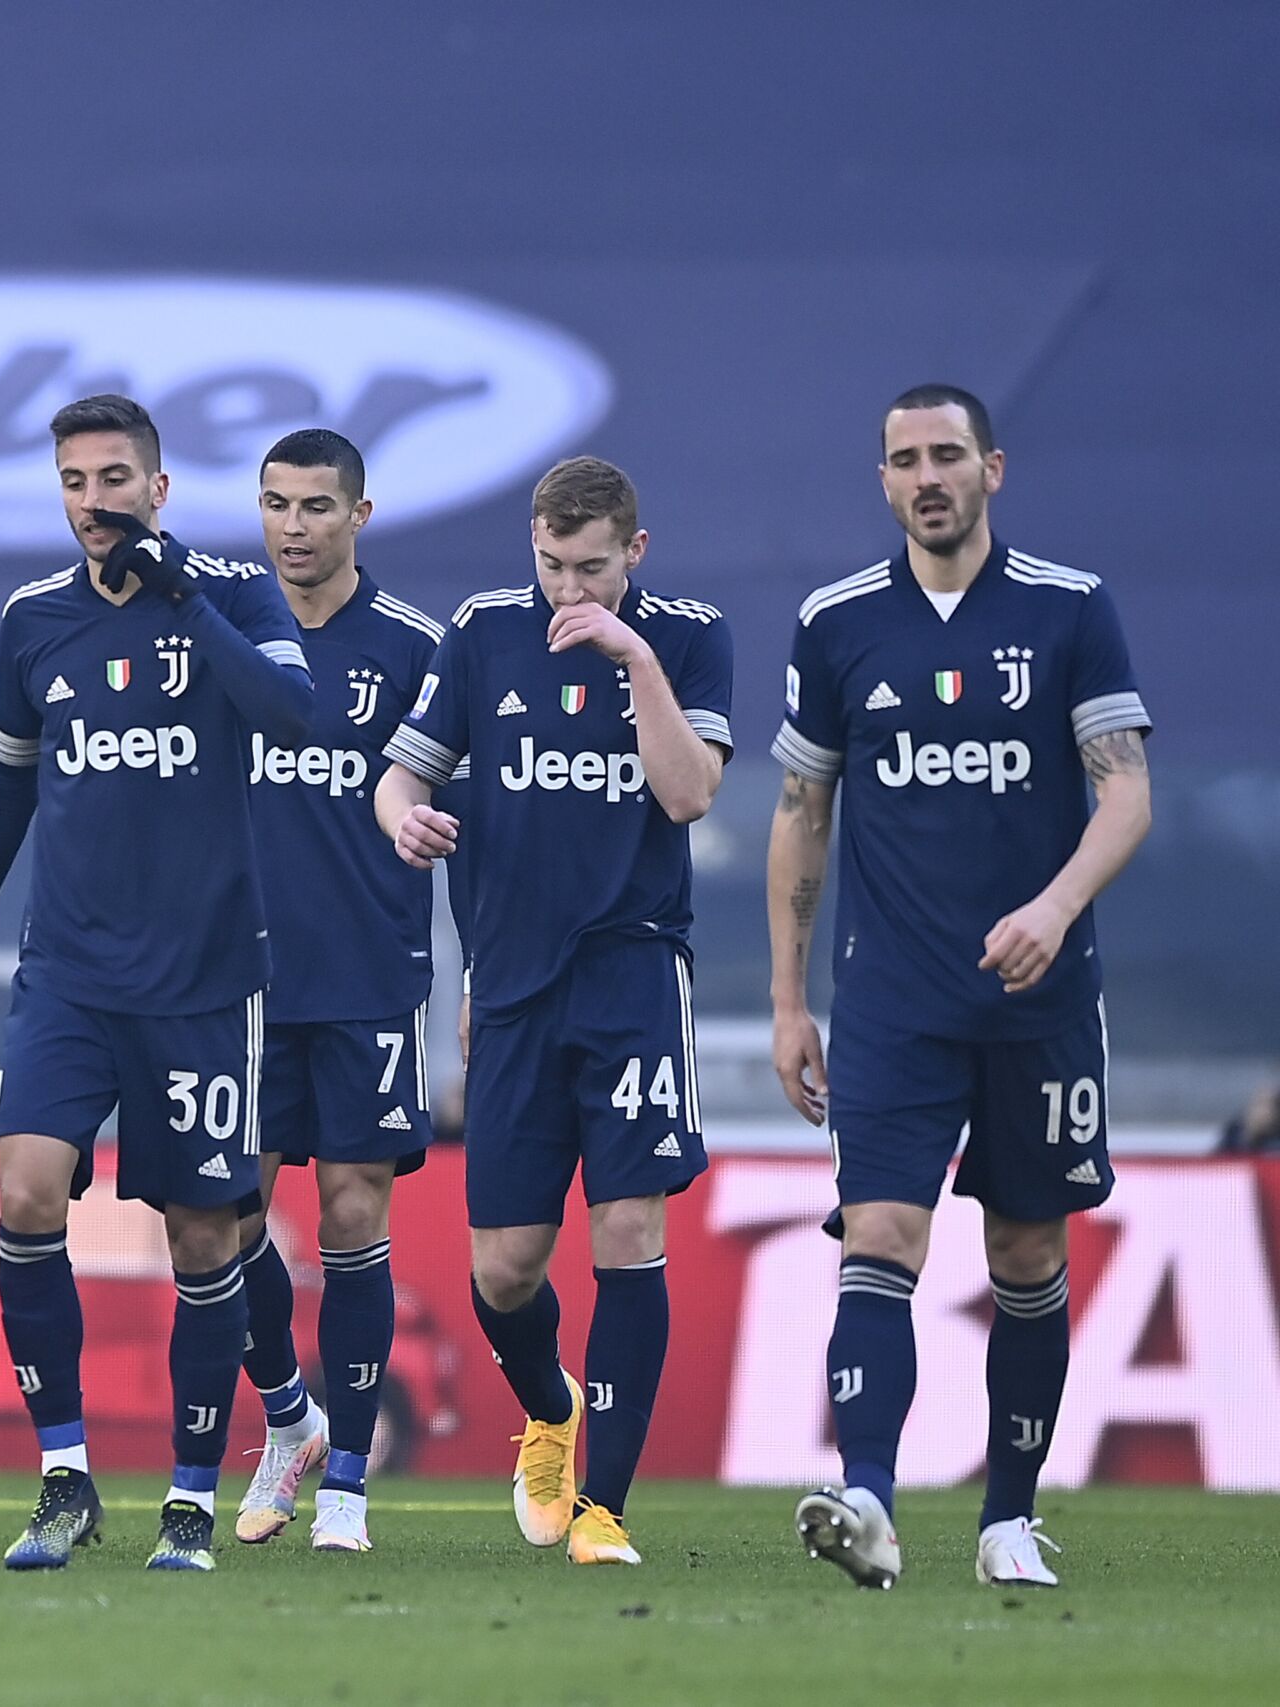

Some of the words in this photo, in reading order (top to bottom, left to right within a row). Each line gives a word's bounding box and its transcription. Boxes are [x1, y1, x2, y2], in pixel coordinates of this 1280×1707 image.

[56, 718, 197, 778] Jeep
[250, 733, 368, 797] Jeep
[500, 736, 646, 803] Jeep
[876, 730, 1032, 794] Jeep
[376, 1032, 404, 1093] 7
[611, 1055, 680, 1120] 44
[166, 1070, 239, 1140] 30
[1041, 1076, 1099, 1144] 19
